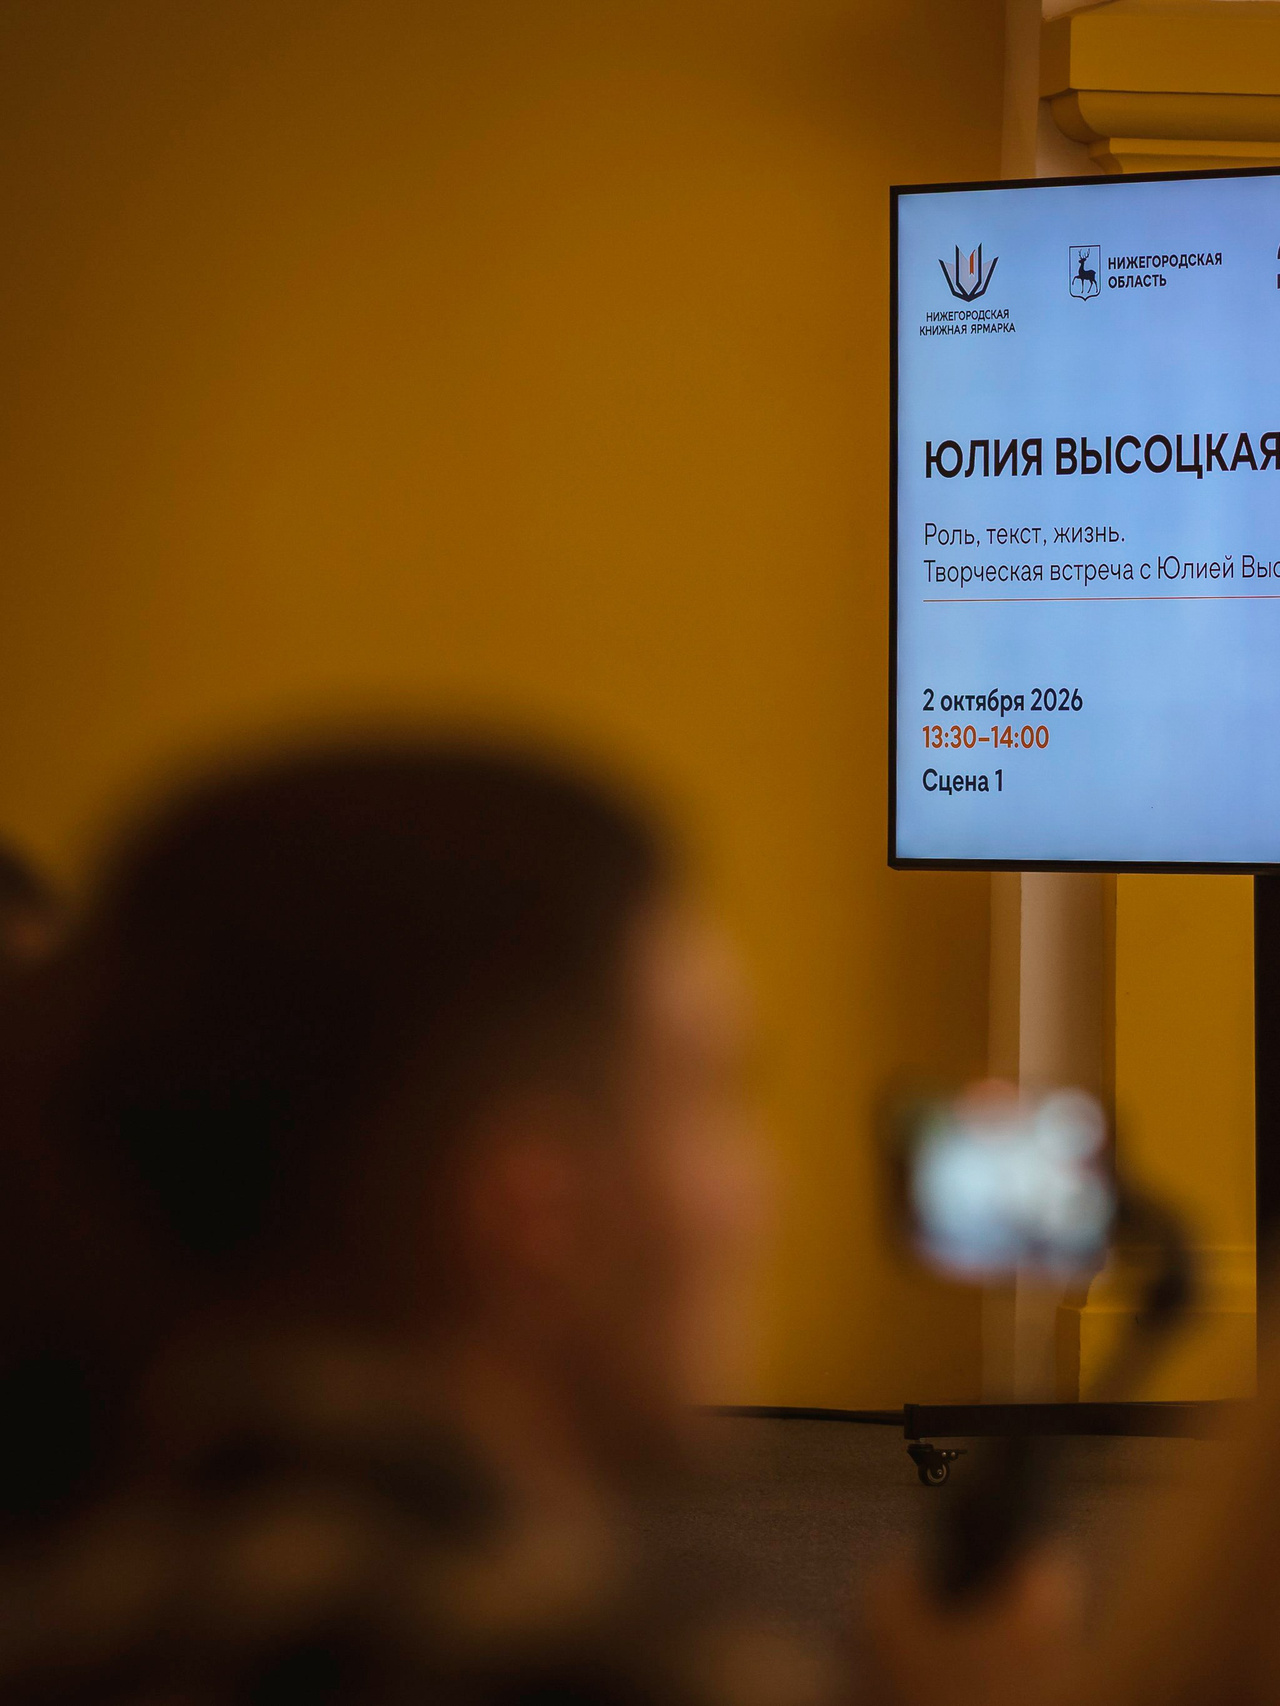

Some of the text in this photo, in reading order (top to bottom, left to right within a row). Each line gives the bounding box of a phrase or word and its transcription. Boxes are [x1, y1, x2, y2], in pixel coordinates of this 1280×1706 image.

[1108, 252, 1222, 270] НИЖЕГОРОДСКАЯ
[1108, 273, 1167, 289] ОБЛАСТЬ
[926, 308, 1010, 323] НИЖЕГОРОДСКАЯ
[919, 322, 1016, 336] КНИЖНАЯ ЯРМАРКА
[925, 438, 1043, 479] ЮЛИЯ
[924, 523, 1125, 548] Роль, текст, жизнь.
[923, 559, 1043, 588] Творческая
[1050, 560, 1134, 586] встреча
[1139, 563, 1151, 579] с
[1157, 555, 1234, 580] Юлией
[922, 688, 1084, 717] 2 октября 2026
[922, 768, 1003, 796] Сцена 1
